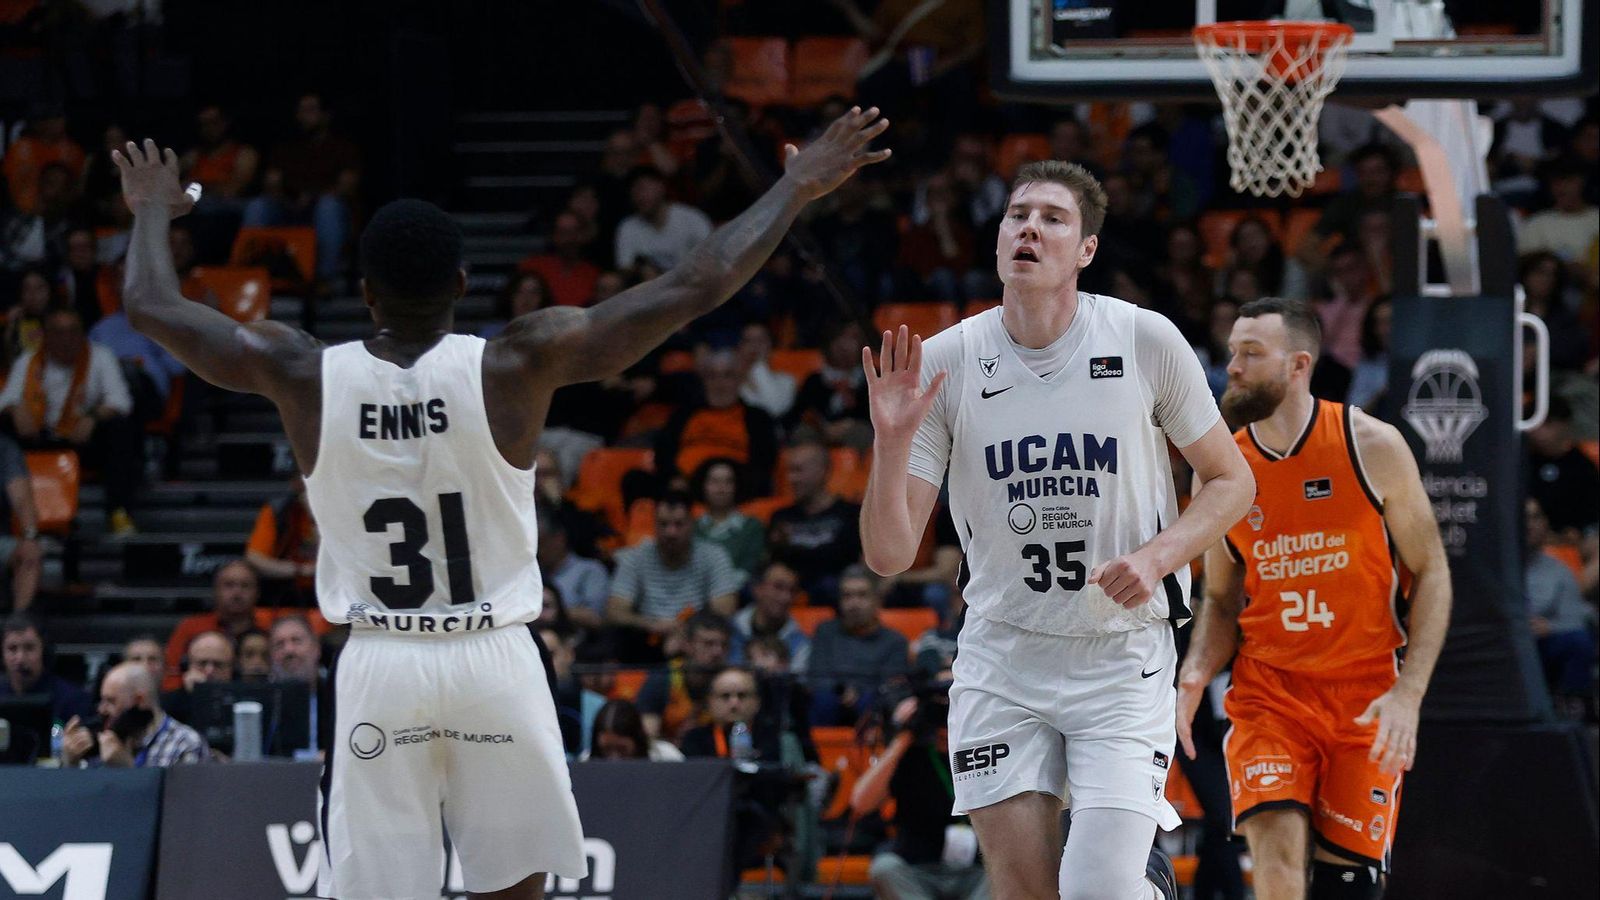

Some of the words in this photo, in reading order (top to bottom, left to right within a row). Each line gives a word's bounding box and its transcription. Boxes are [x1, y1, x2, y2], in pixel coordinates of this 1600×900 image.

[360, 398, 448, 440] ENNIS
[985, 433, 1117, 480] UCAM
[1007, 475, 1100, 503] MURCIA
[1042, 511, 1077, 521] REGIÓN
[1042, 522, 1055, 530] DE
[1057, 520, 1094, 530] MURCIA
[363, 492, 476, 609] 31
[1253, 531, 1325, 560] Cultura
[1326, 534, 1346, 548] del
[1021, 540, 1086, 593] 35
[1256, 551, 1350, 581] Esfuerzo
[1279, 589, 1335, 632] 24
[444, 729, 460, 740] DE
[463, 733, 514, 744] MURCIA
[953, 742, 1010, 774] ESP
[1245, 761, 1293, 781] PULEVA
